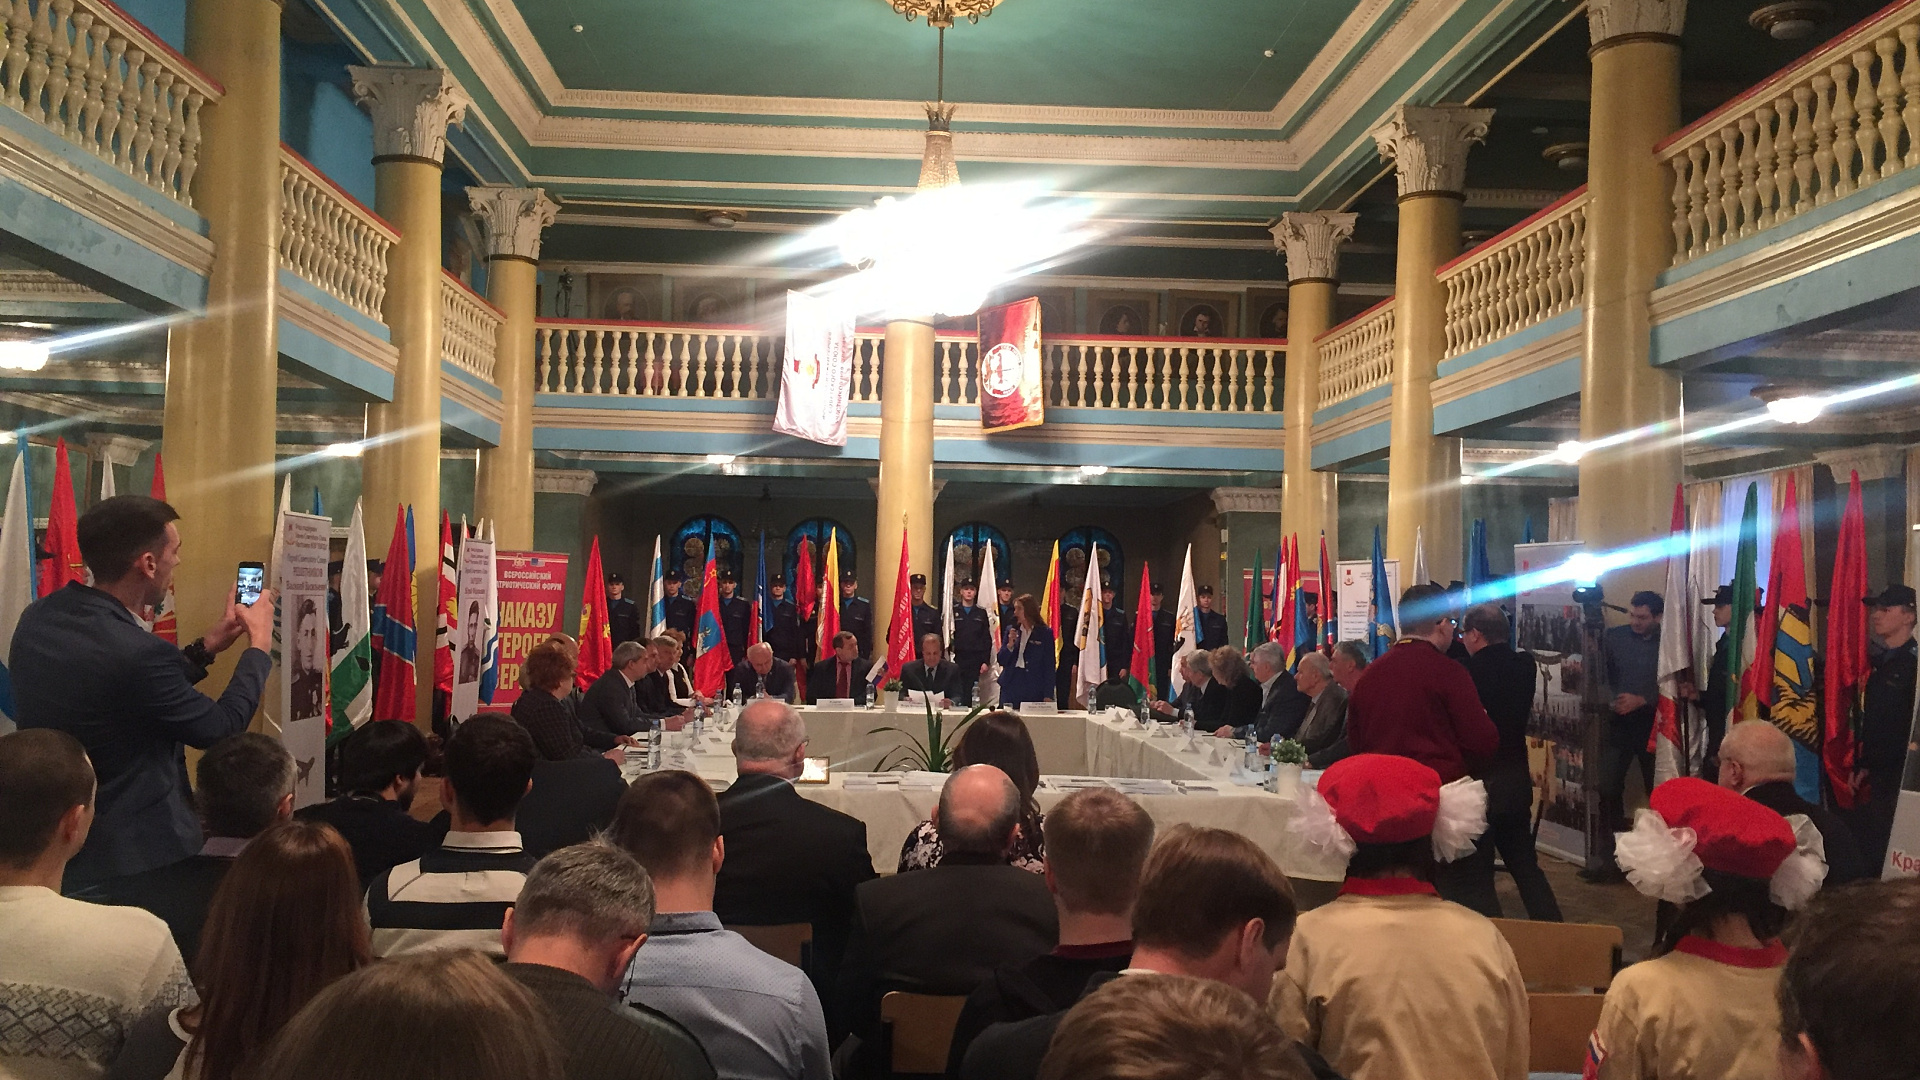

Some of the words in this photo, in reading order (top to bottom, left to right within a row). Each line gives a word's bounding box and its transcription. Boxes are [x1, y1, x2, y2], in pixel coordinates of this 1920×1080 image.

[503, 570, 552, 580] ВСЕРОССИЙСКИЙ
[496, 580, 541, 590] АТРИОТИЧЕСКИЙ
[542, 583, 562, 591] ФОРУМ
